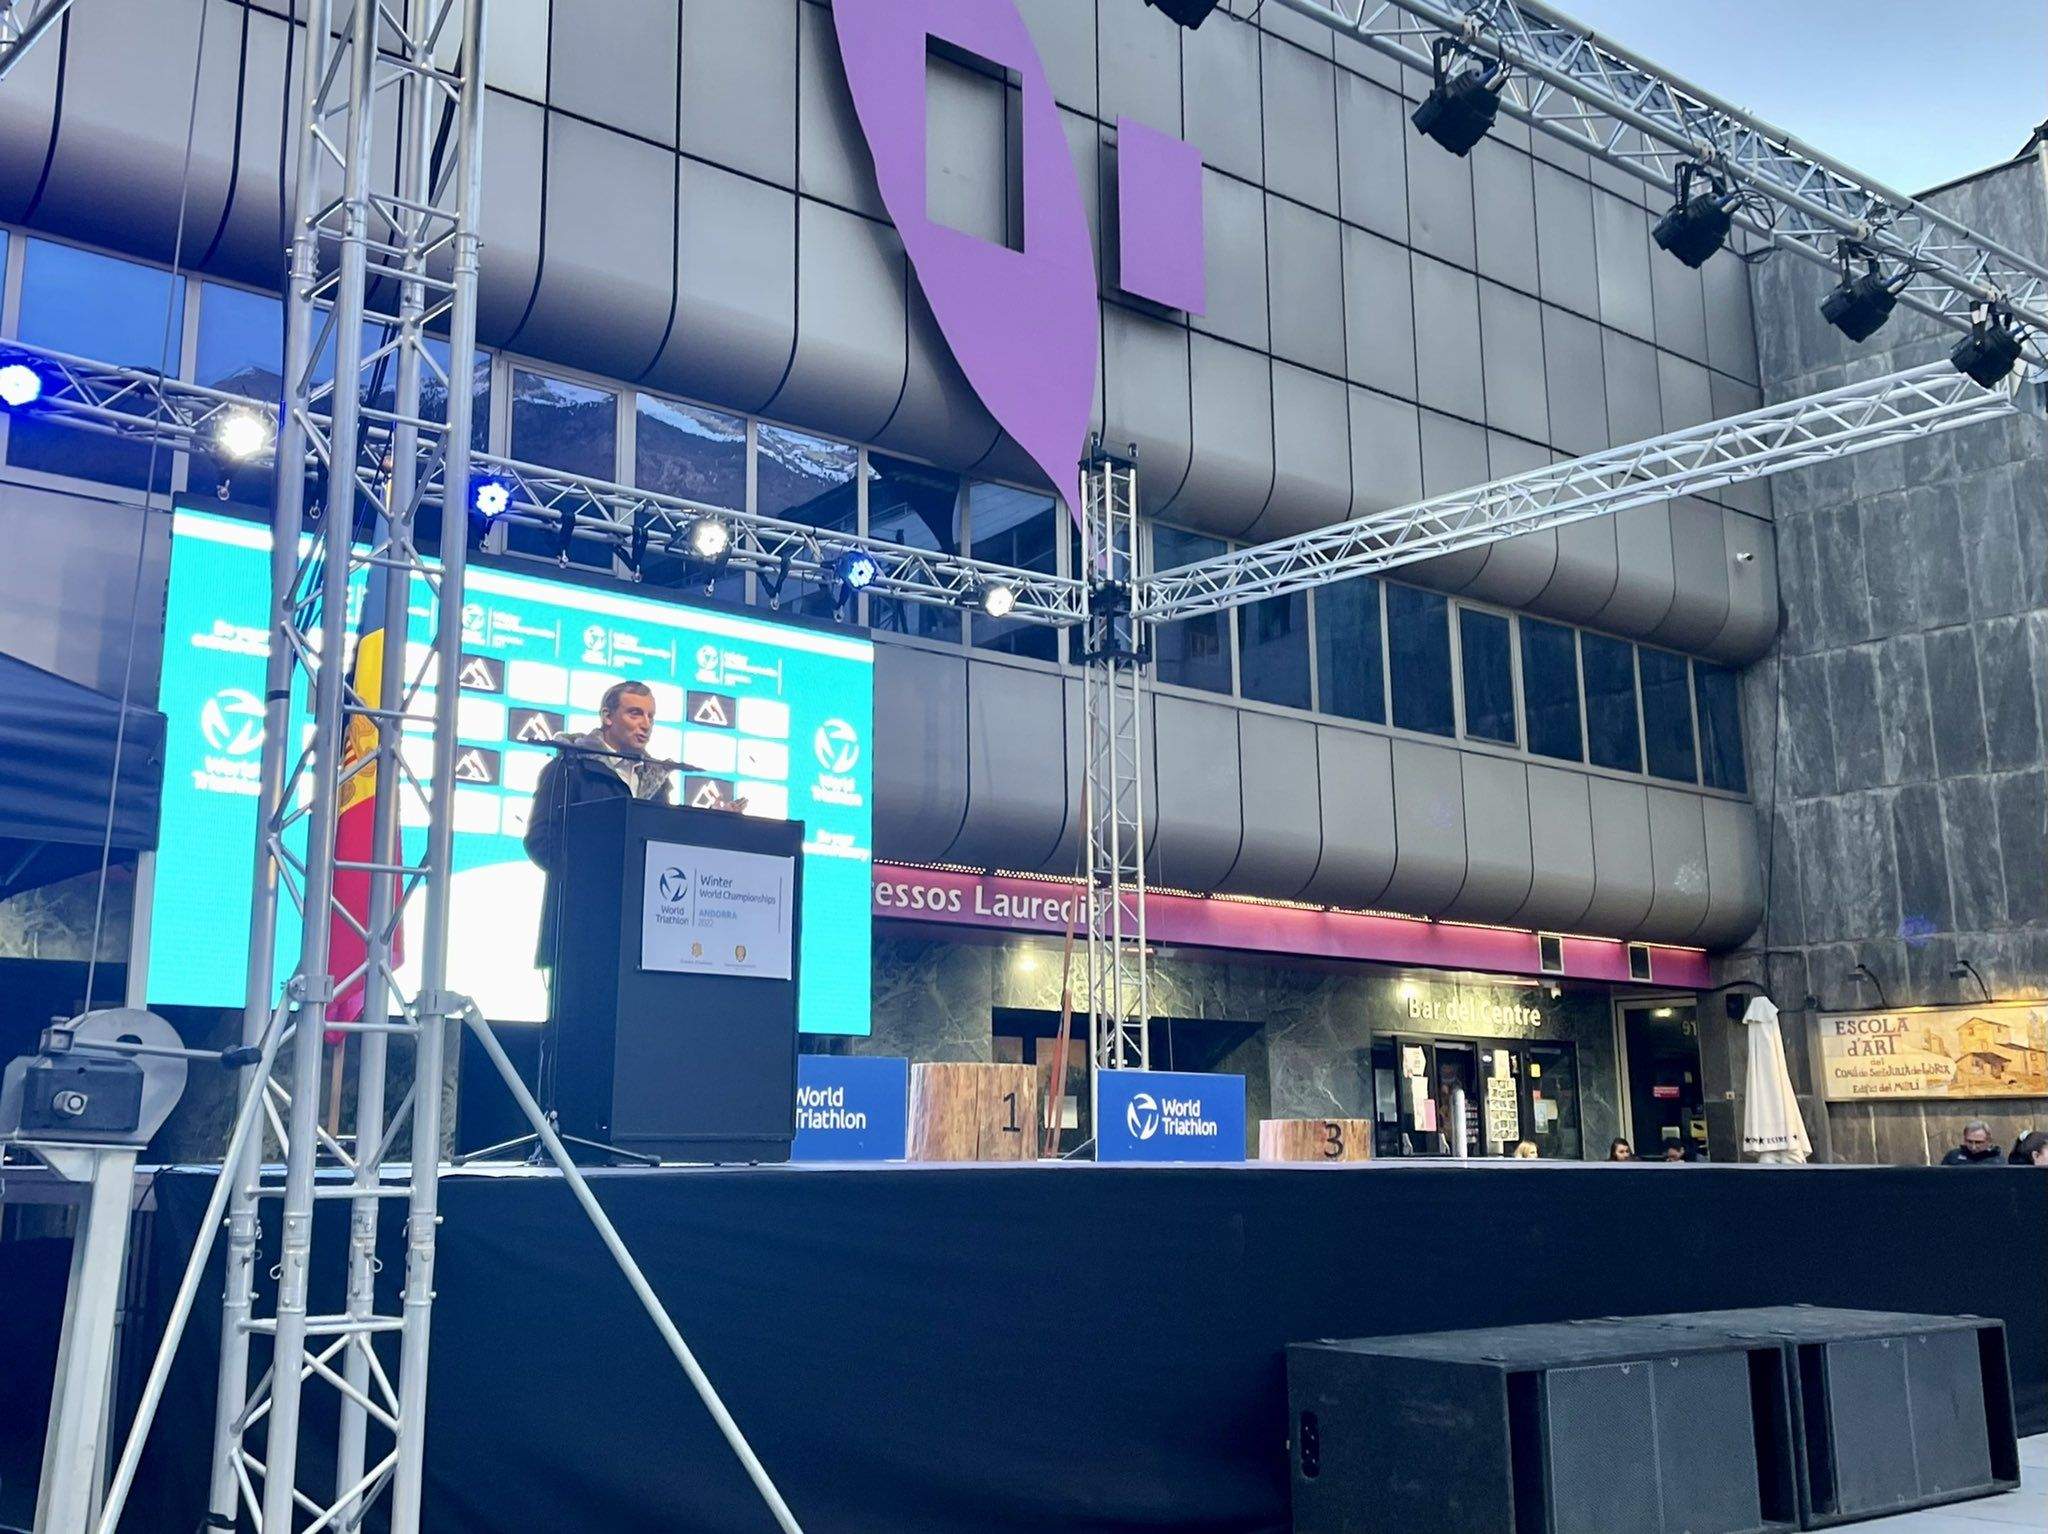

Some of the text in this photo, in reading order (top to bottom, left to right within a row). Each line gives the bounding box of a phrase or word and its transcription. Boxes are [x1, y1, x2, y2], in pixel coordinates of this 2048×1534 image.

[700, 874, 733, 888] Winter
[699, 889, 776, 905] World Championships
[873, 882, 961, 912] essos
[656, 915, 689, 926] Triathlon
[661, 904, 685, 917] World
[699, 908, 738, 920] ANDORRA
[1408, 997, 1542, 1028] Bar del Centre
[1835, 1017, 1910, 1036] ESCOLA
[1847, 1035, 1902, 1057] d'ART
[1002, 1092, 1021, 1133] 1
[1161, 1098, 1202, 1118] World
[795, 1108, 867, 1130] Triathlon
[1162, 1116, 1218, 1137] Triathlon
[1323, 1121, 1344, 1158] 3
